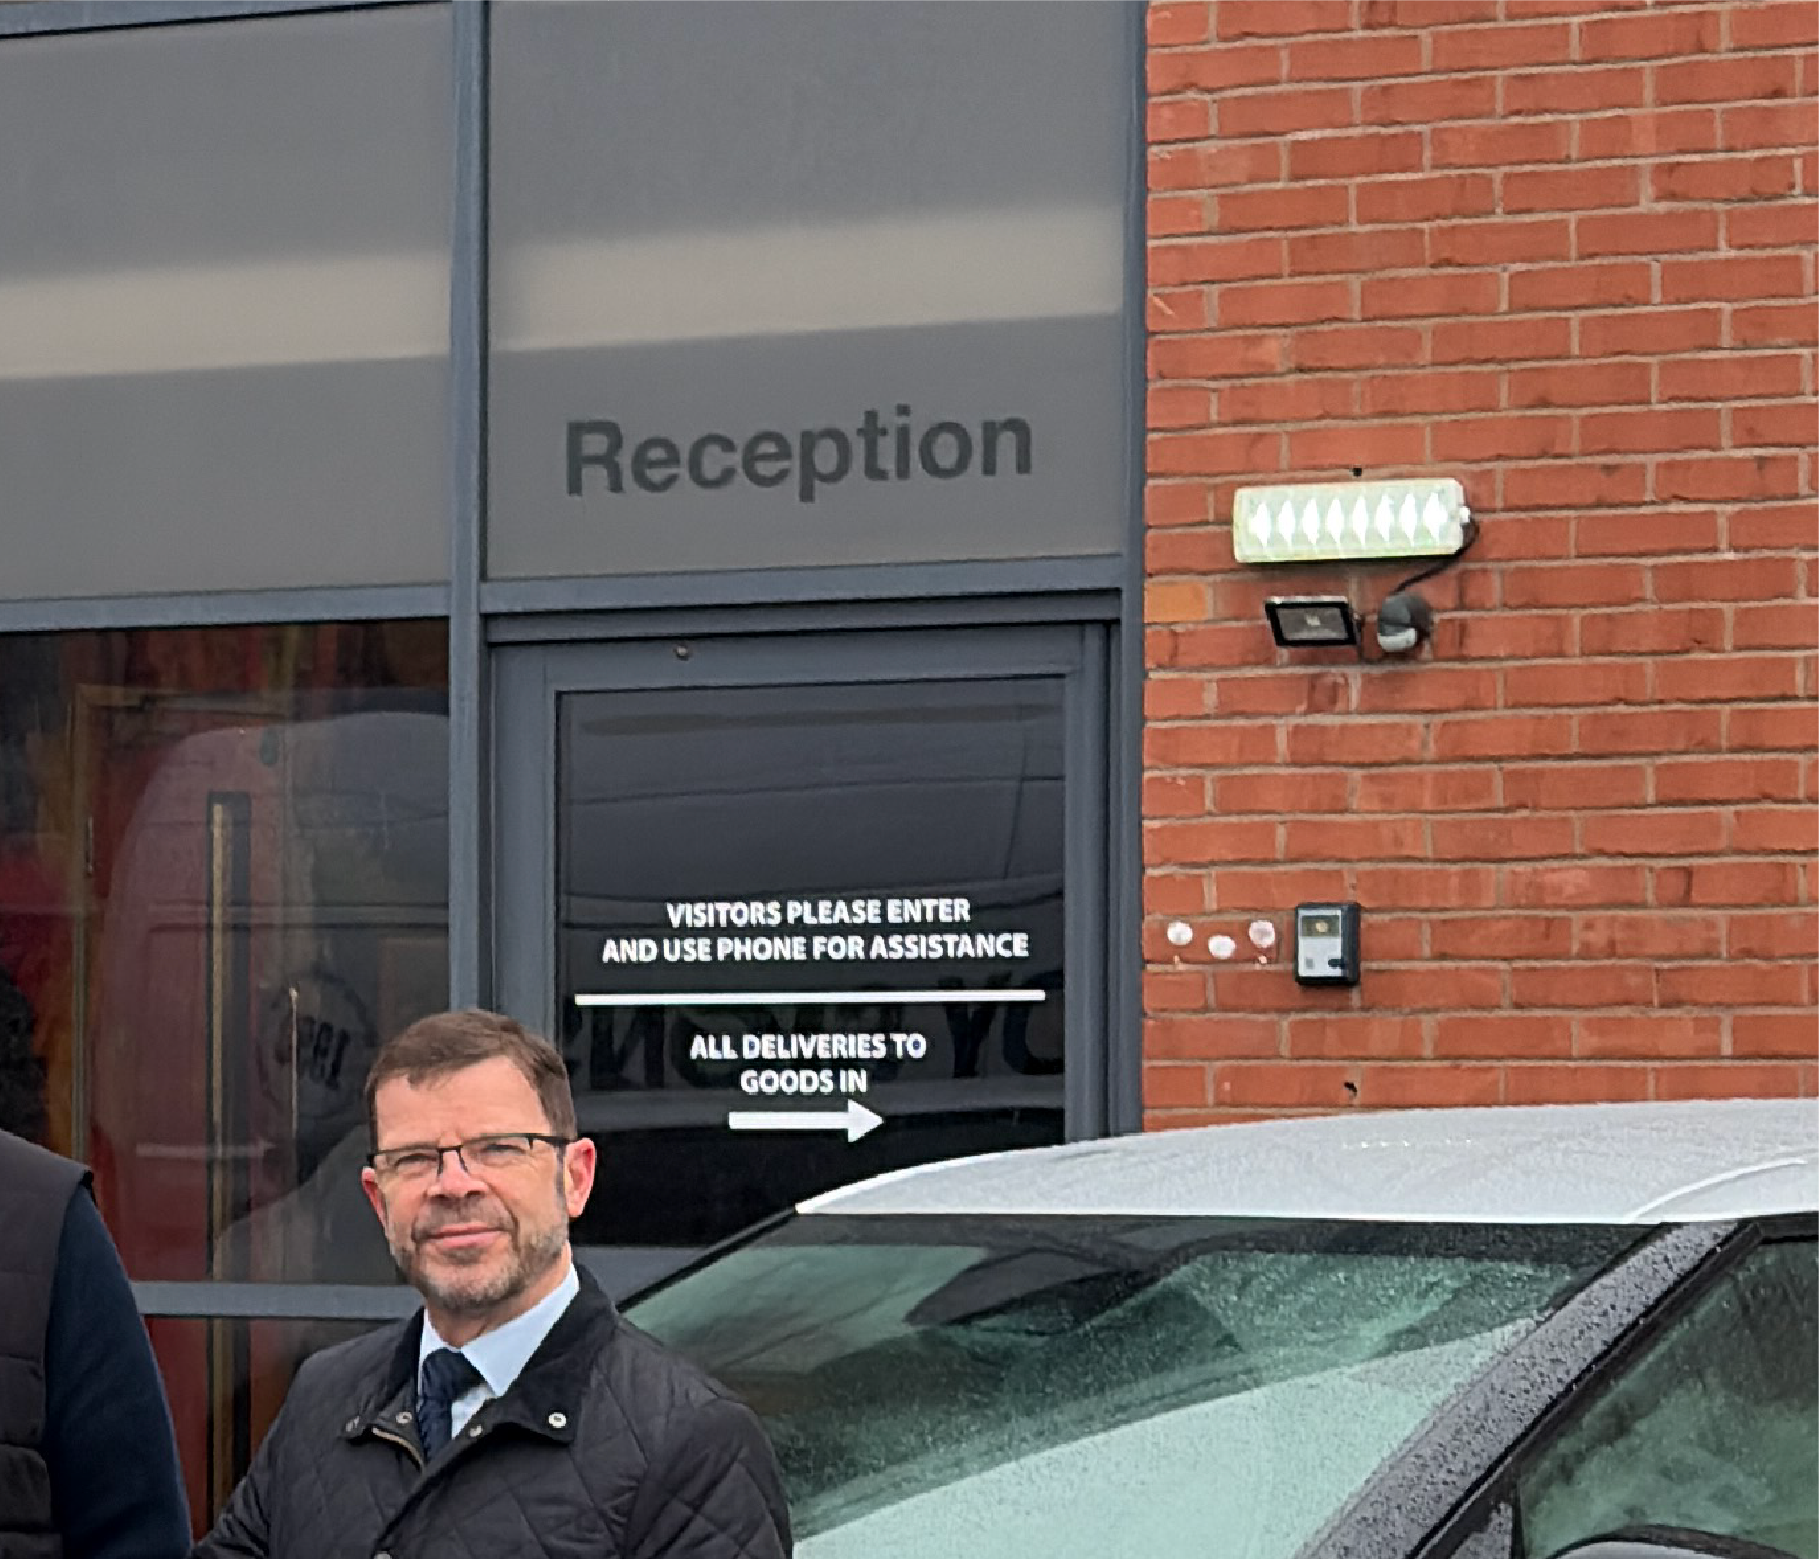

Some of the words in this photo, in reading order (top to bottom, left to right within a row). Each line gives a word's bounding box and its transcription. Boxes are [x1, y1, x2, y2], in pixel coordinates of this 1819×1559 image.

[565, 403, 1032, 503] Reception
[666, 899, 782, 928] VISITORS
[786, 899, 882, 925] PLEASE
[887, 898, 971, 924] ENTER
[602, 938, 658, 964] AND
[662, 936, 713, 962] USE
[716, 935, 808, 962] PHONE
[812, 935, 866, 961] FOR
[869, 932, 1030, 960] ASSISTANCE
[689, 1034, 739, 1060] ALL
[742, 1033, 887, 1060] DELIVERIES
[889, 1032, 927, 1059] TO
[740, 1069, 834, 1096] GOODS
[839, 1069, 867, 1093] IN
